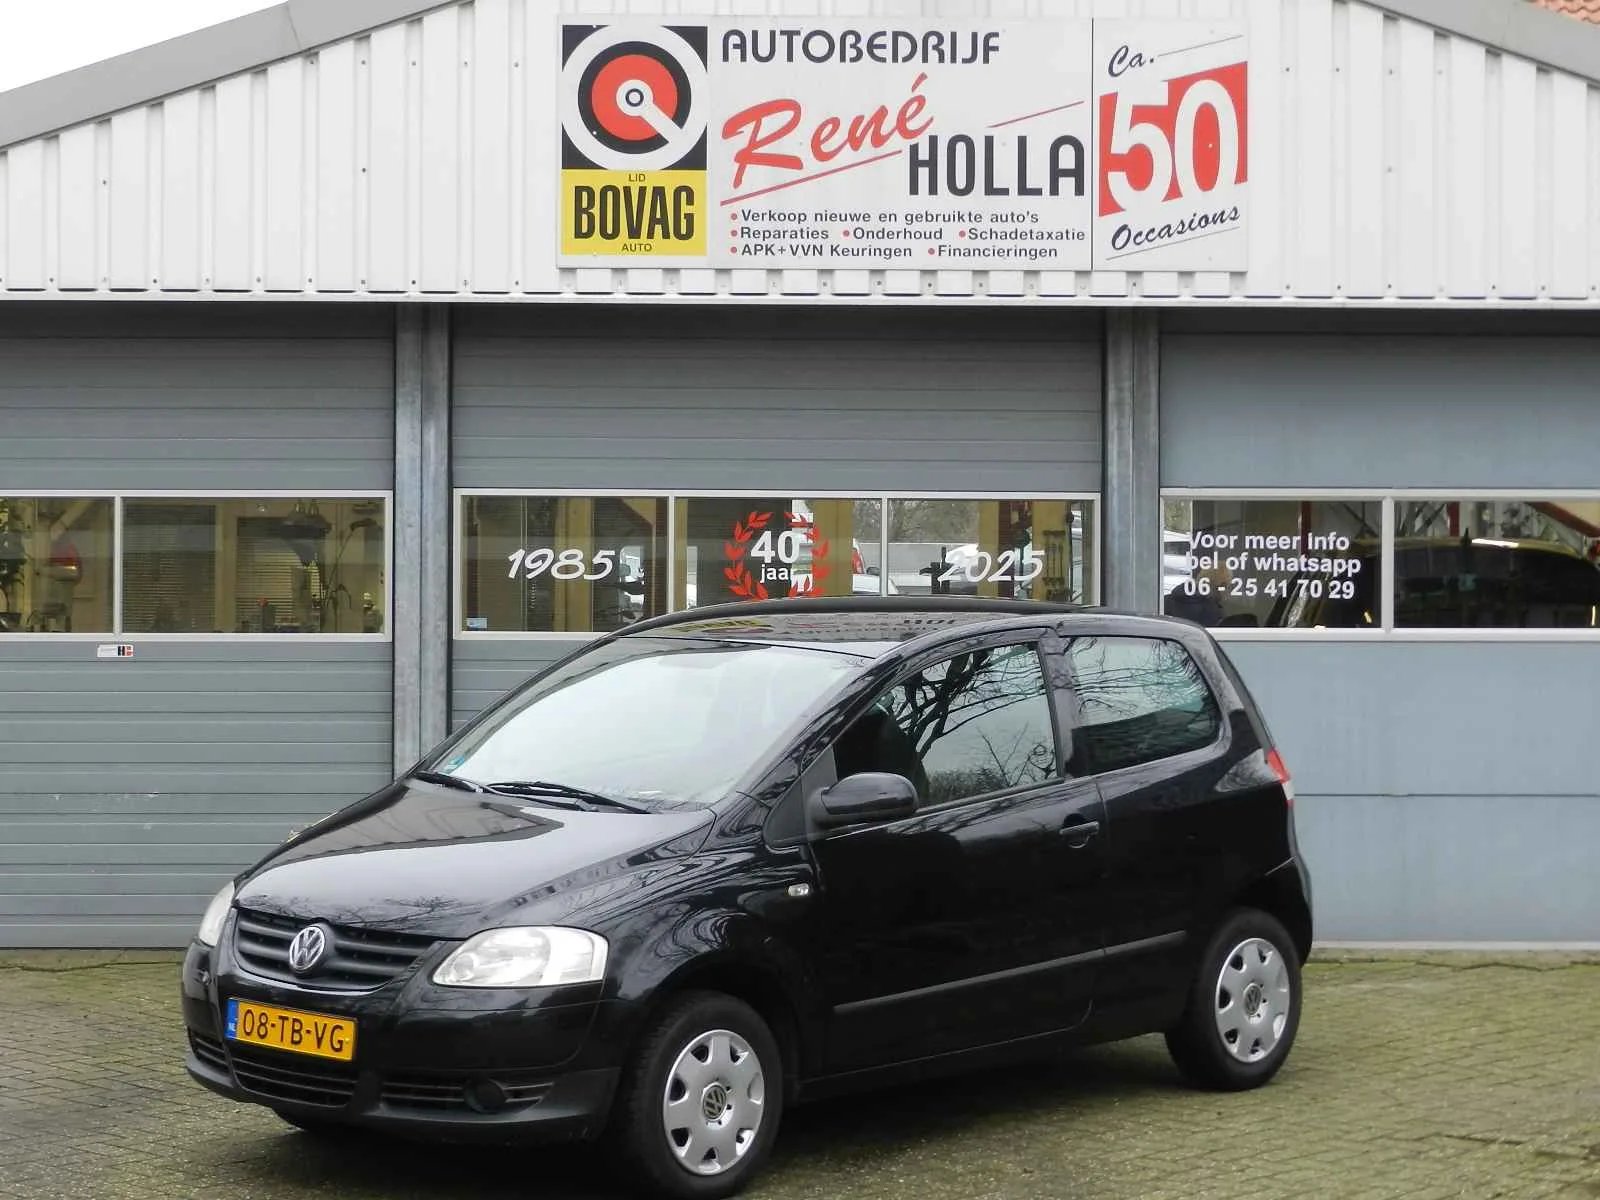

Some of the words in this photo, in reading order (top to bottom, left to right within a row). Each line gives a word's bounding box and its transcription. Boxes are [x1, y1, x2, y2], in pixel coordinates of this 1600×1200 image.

[721, 28, 1000, 65] AUTOBEDRIJF
[1107, 44, 1155, 78] Ca.
[720, 71, 935, 189] René
[1106, 79, 1239, 212] 50
[628, 173, 646, 183] LID
[908, 133, 1085, 197] HOLLA
[574, 184, 695, 241] BOVAG
[741, 209, 808, 224] Verkoop
[814, 209, 871, 222] nieuwe
[878, 212, 898, 223] en
[904, 210, 983, 226] gebruikte
[990, 210, 1039, 224] auto's
[740, 226, 829, 242] Reparaties
[853, 226, 943, 240] Onderhoud
[967, 227, 1085, 241] Schadetaxatie
[1110, 205, 1241, 251] Occasions
[621, 242, 653, 253] AUTO
[830, 244, 912, 260] Keuringen
[937, 244, 1058, 261] Financieringen
[750, 530, 801, 564] 40
[1244, 534, 1301, 550] meer
[507, 548, 616, 580] 1985
[937, 549, 1045, 582] 2025
[1186, 551, 1219, 571] bel
[1225, 551, 1249, 570] of
[1253, 552, 1362, 578] whatsapp
[1183, 577, 1211, 597] 06
[1231, 577, 1258, 597] 25
[1264, 578, 1288, 598] 41
[1297, 579, 1323, 599] 70
[1328, 580, 1355, 600] 29
[242, 1008, 345, 1053] 08-TB-VG
